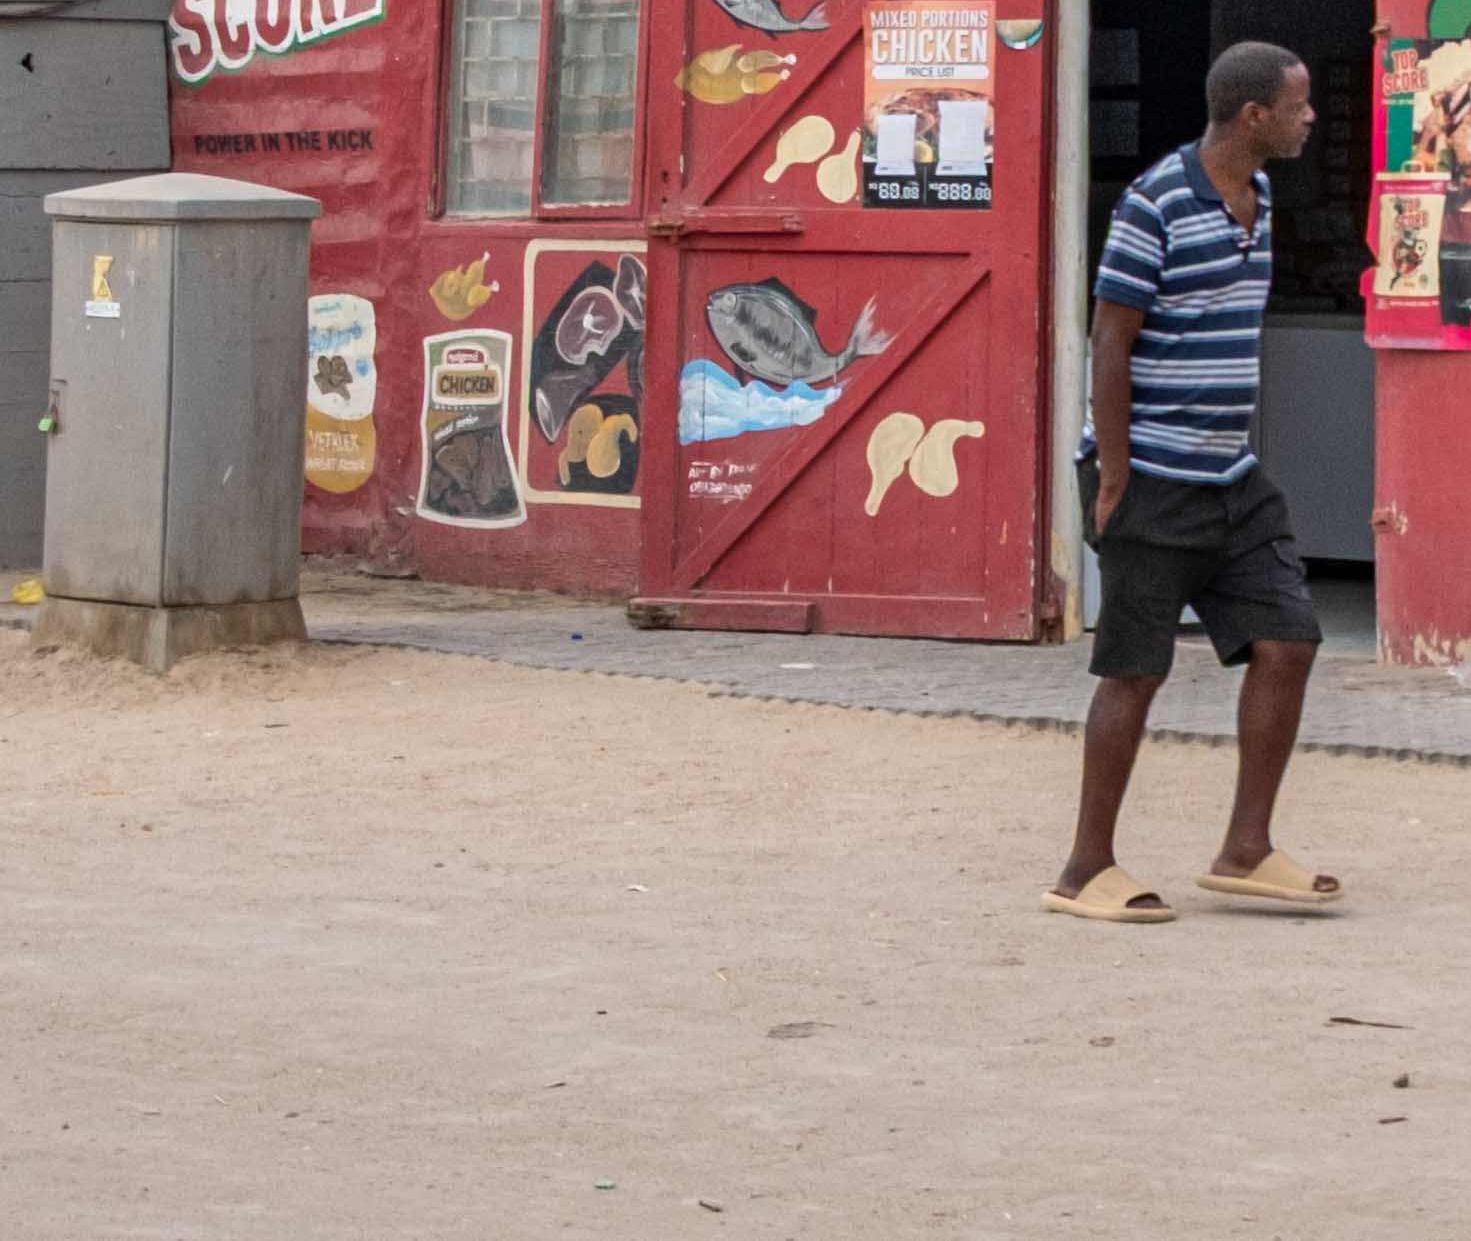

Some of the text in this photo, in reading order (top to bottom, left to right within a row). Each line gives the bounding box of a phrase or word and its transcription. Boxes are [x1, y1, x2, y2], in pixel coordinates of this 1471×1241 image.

[870, 9, 989, 28] MIXED PORTIONS
[872, 28, 988, 64] CHICKEN
[1392, 49, 1419, 71] TOP
[905, 66, 955, 78] PRICE LIST
[1382, 70, 1428, 95] SCORE
[194, 129, 374, 155] POWER IN THE KICK
[441, 374, 496, 394] CHICKEN
